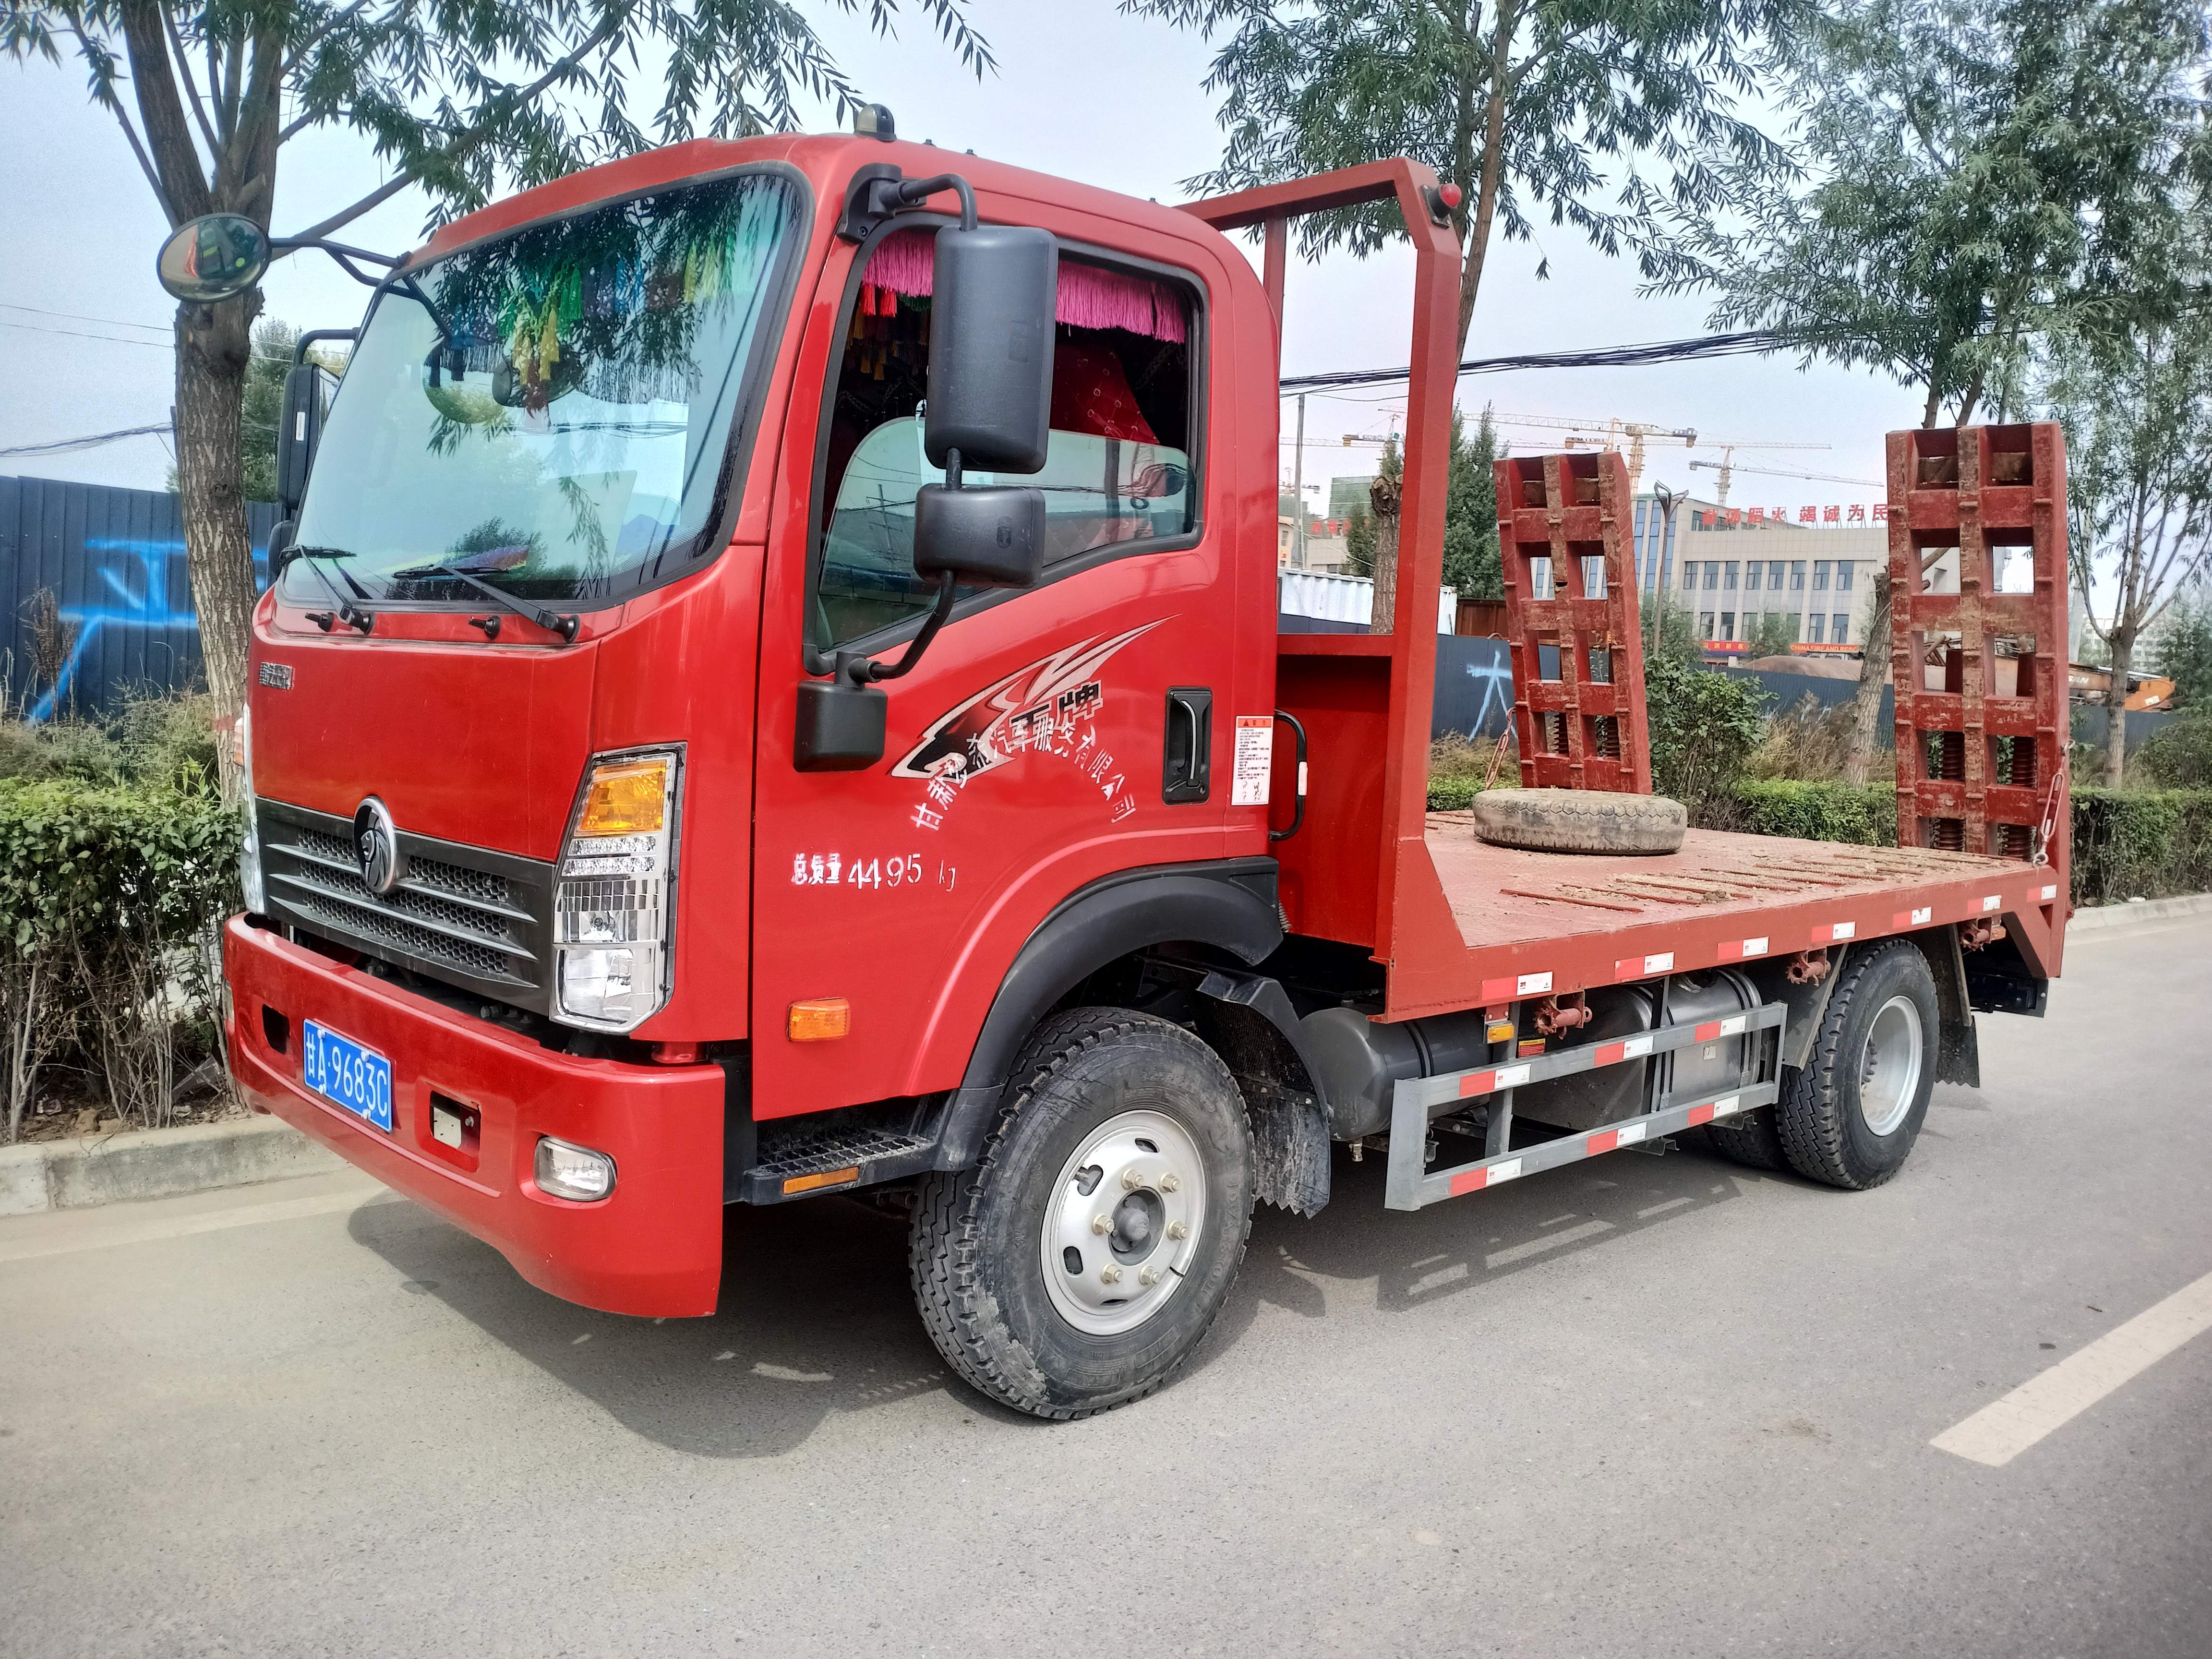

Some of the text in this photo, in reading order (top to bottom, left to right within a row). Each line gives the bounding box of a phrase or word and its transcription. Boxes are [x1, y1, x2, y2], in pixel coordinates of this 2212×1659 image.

[791, 853, 842, 885] 总质量
[848, 854, 922, 890] 4495
